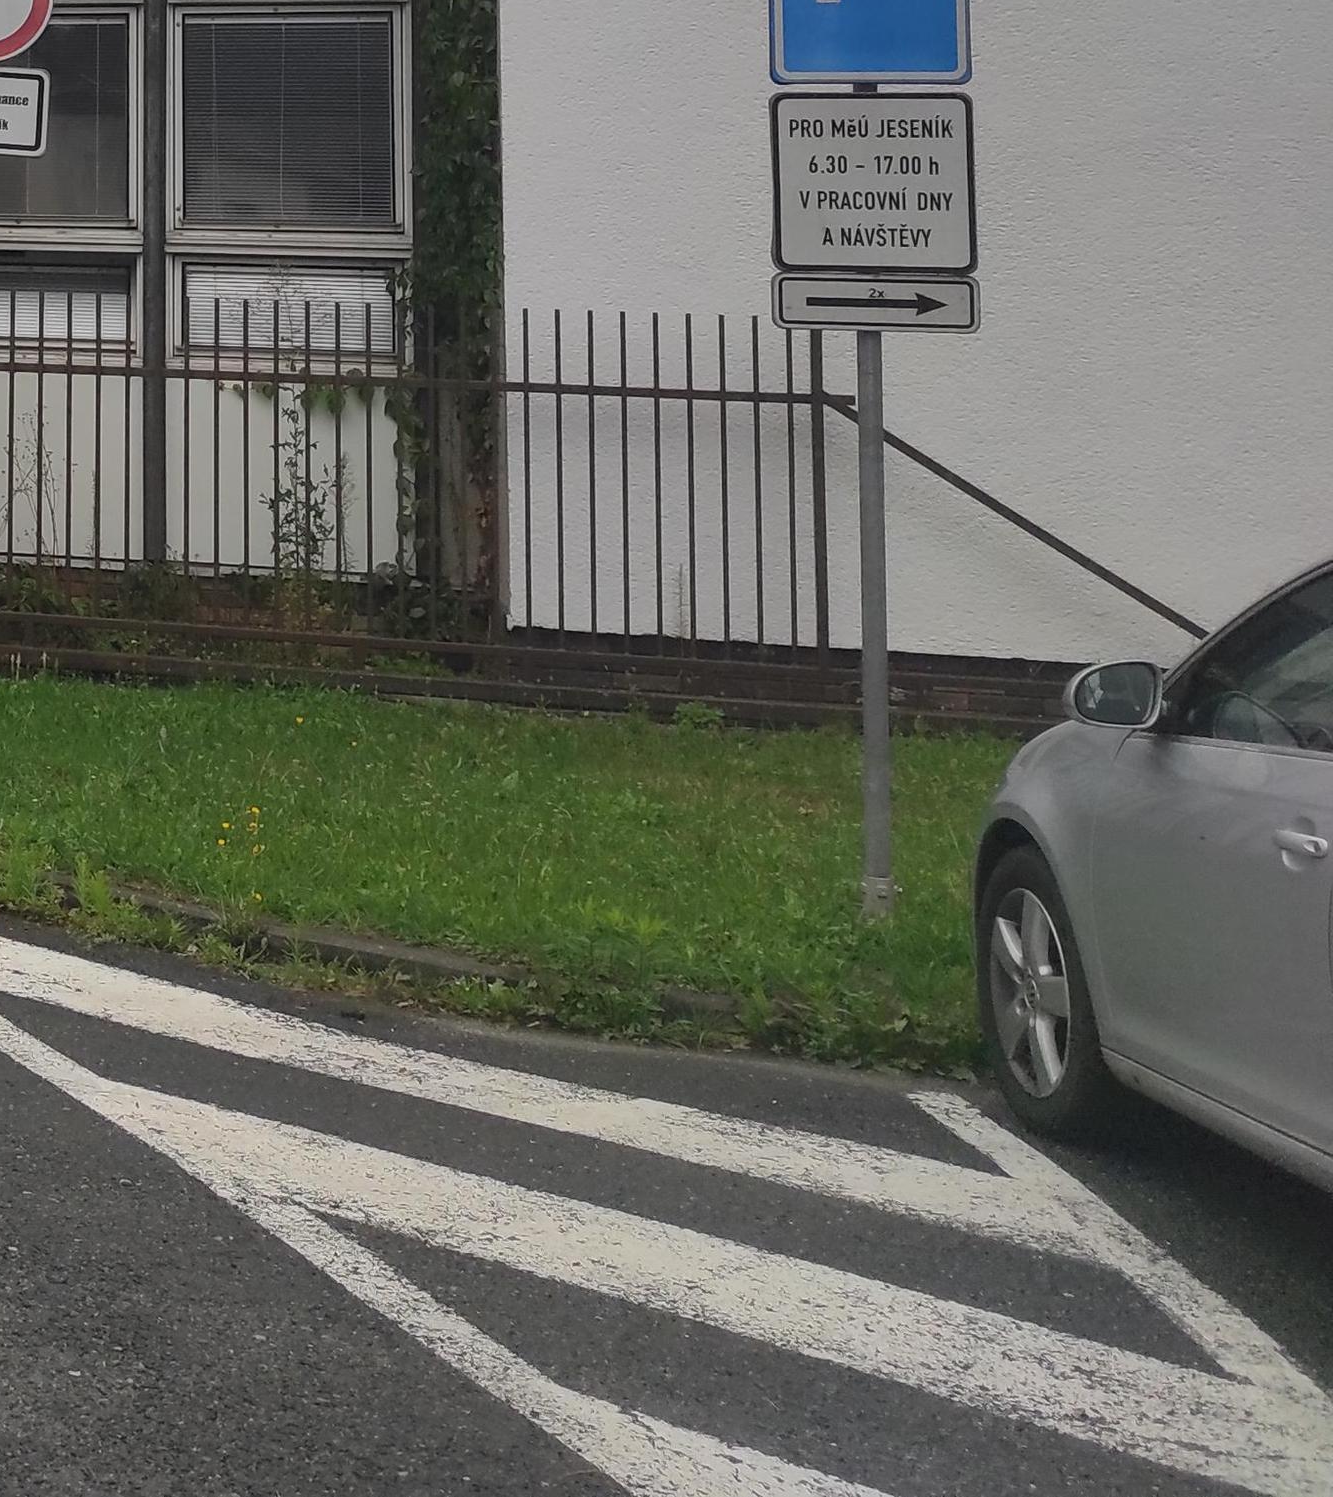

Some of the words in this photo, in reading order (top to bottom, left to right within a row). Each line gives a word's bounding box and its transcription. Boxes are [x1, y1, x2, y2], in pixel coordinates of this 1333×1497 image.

[789, 119, 824, 138] PRO
[832, 115, 869, 138] MěÚ
[875, 115, 954, 138] JESENÍK
[808, 155, 848, 174] 6.30
[874, 155, 921, 175] 17.00
[929, 156, 939, 175] h
[799, 190, 810, 209] V
[817, 187, 907, 211] PRACOVNÍ
[917, 192, 953, 211] DNY
[822, 227, 834, 246] A
[840, 223, 932, 248] NÁVŠTĚVY
[868, 288, 885, 298] 2x
